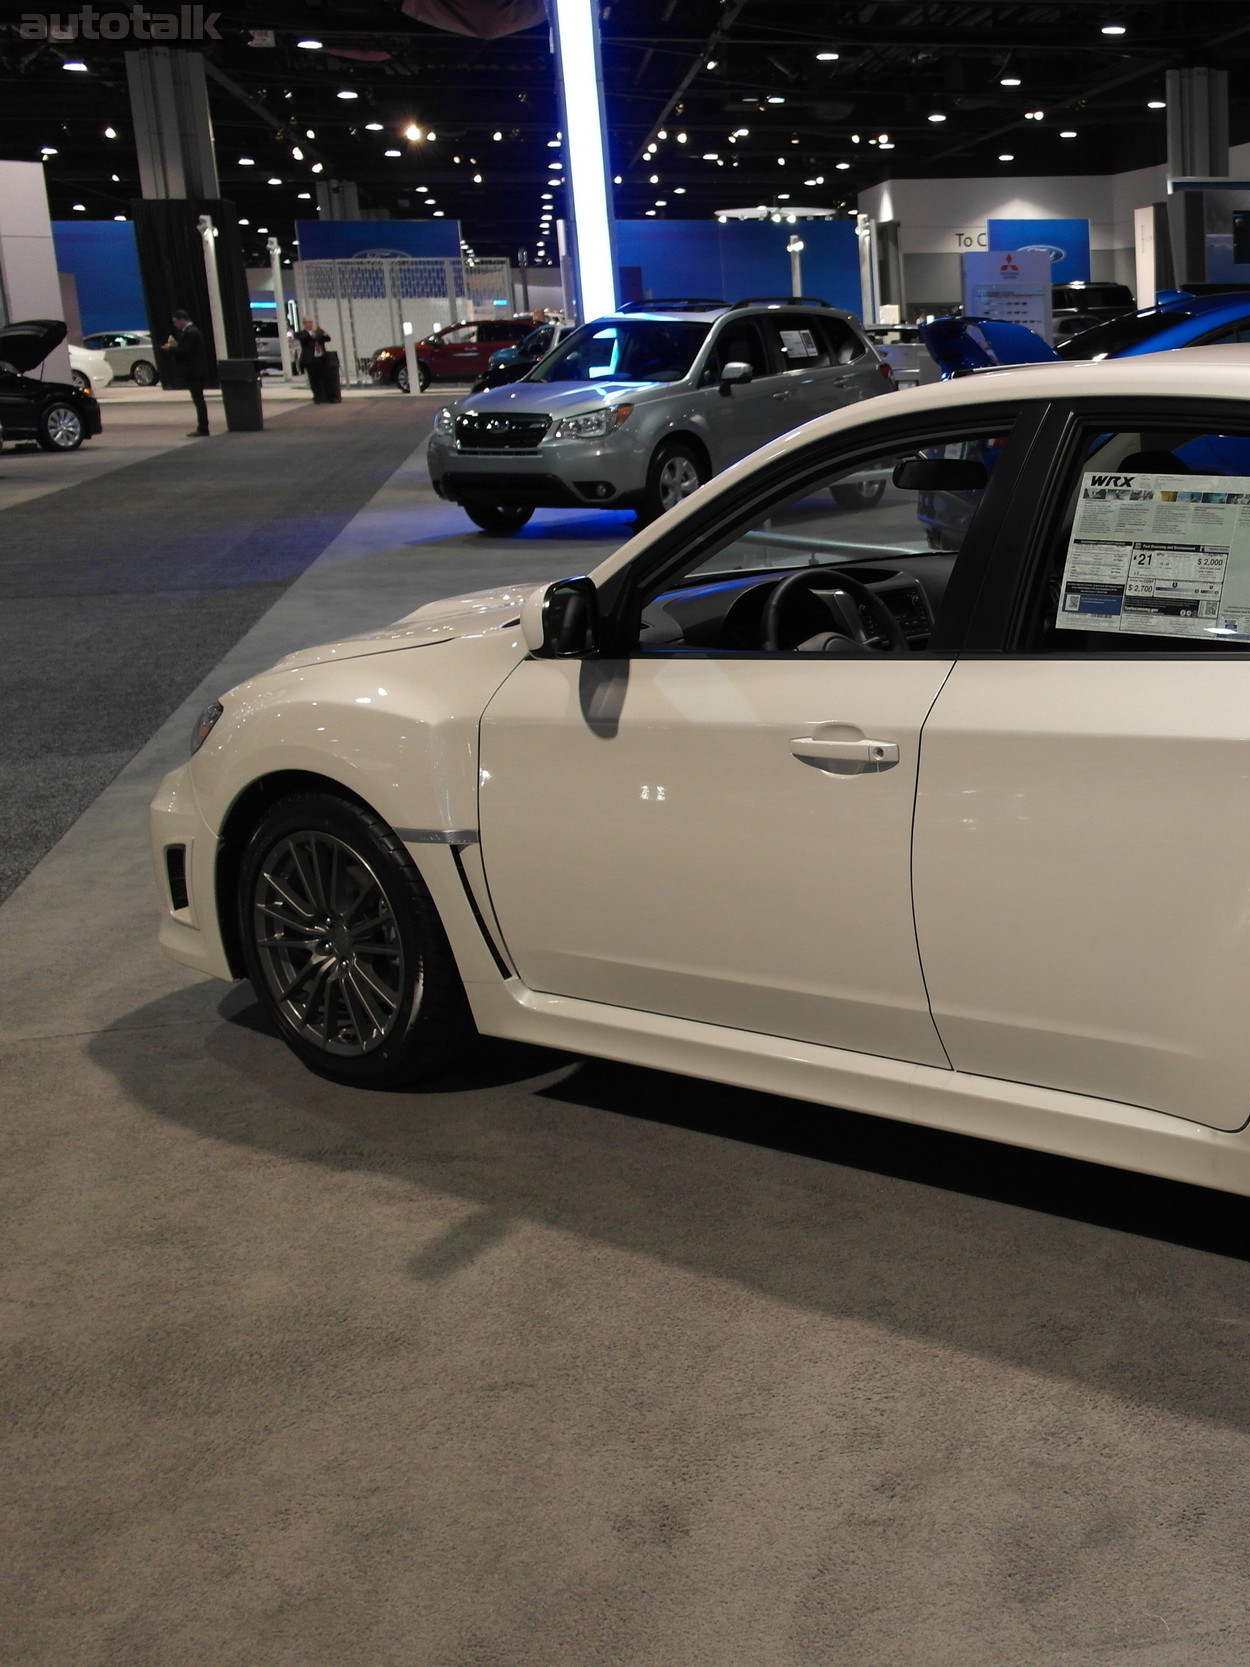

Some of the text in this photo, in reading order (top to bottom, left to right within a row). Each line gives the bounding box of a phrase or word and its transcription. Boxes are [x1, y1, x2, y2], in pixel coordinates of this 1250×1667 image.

[955, 233, 973, 248] To
[1090, 475, 1135, 488] WRX
[1137, 553, 1152, 566] 21
